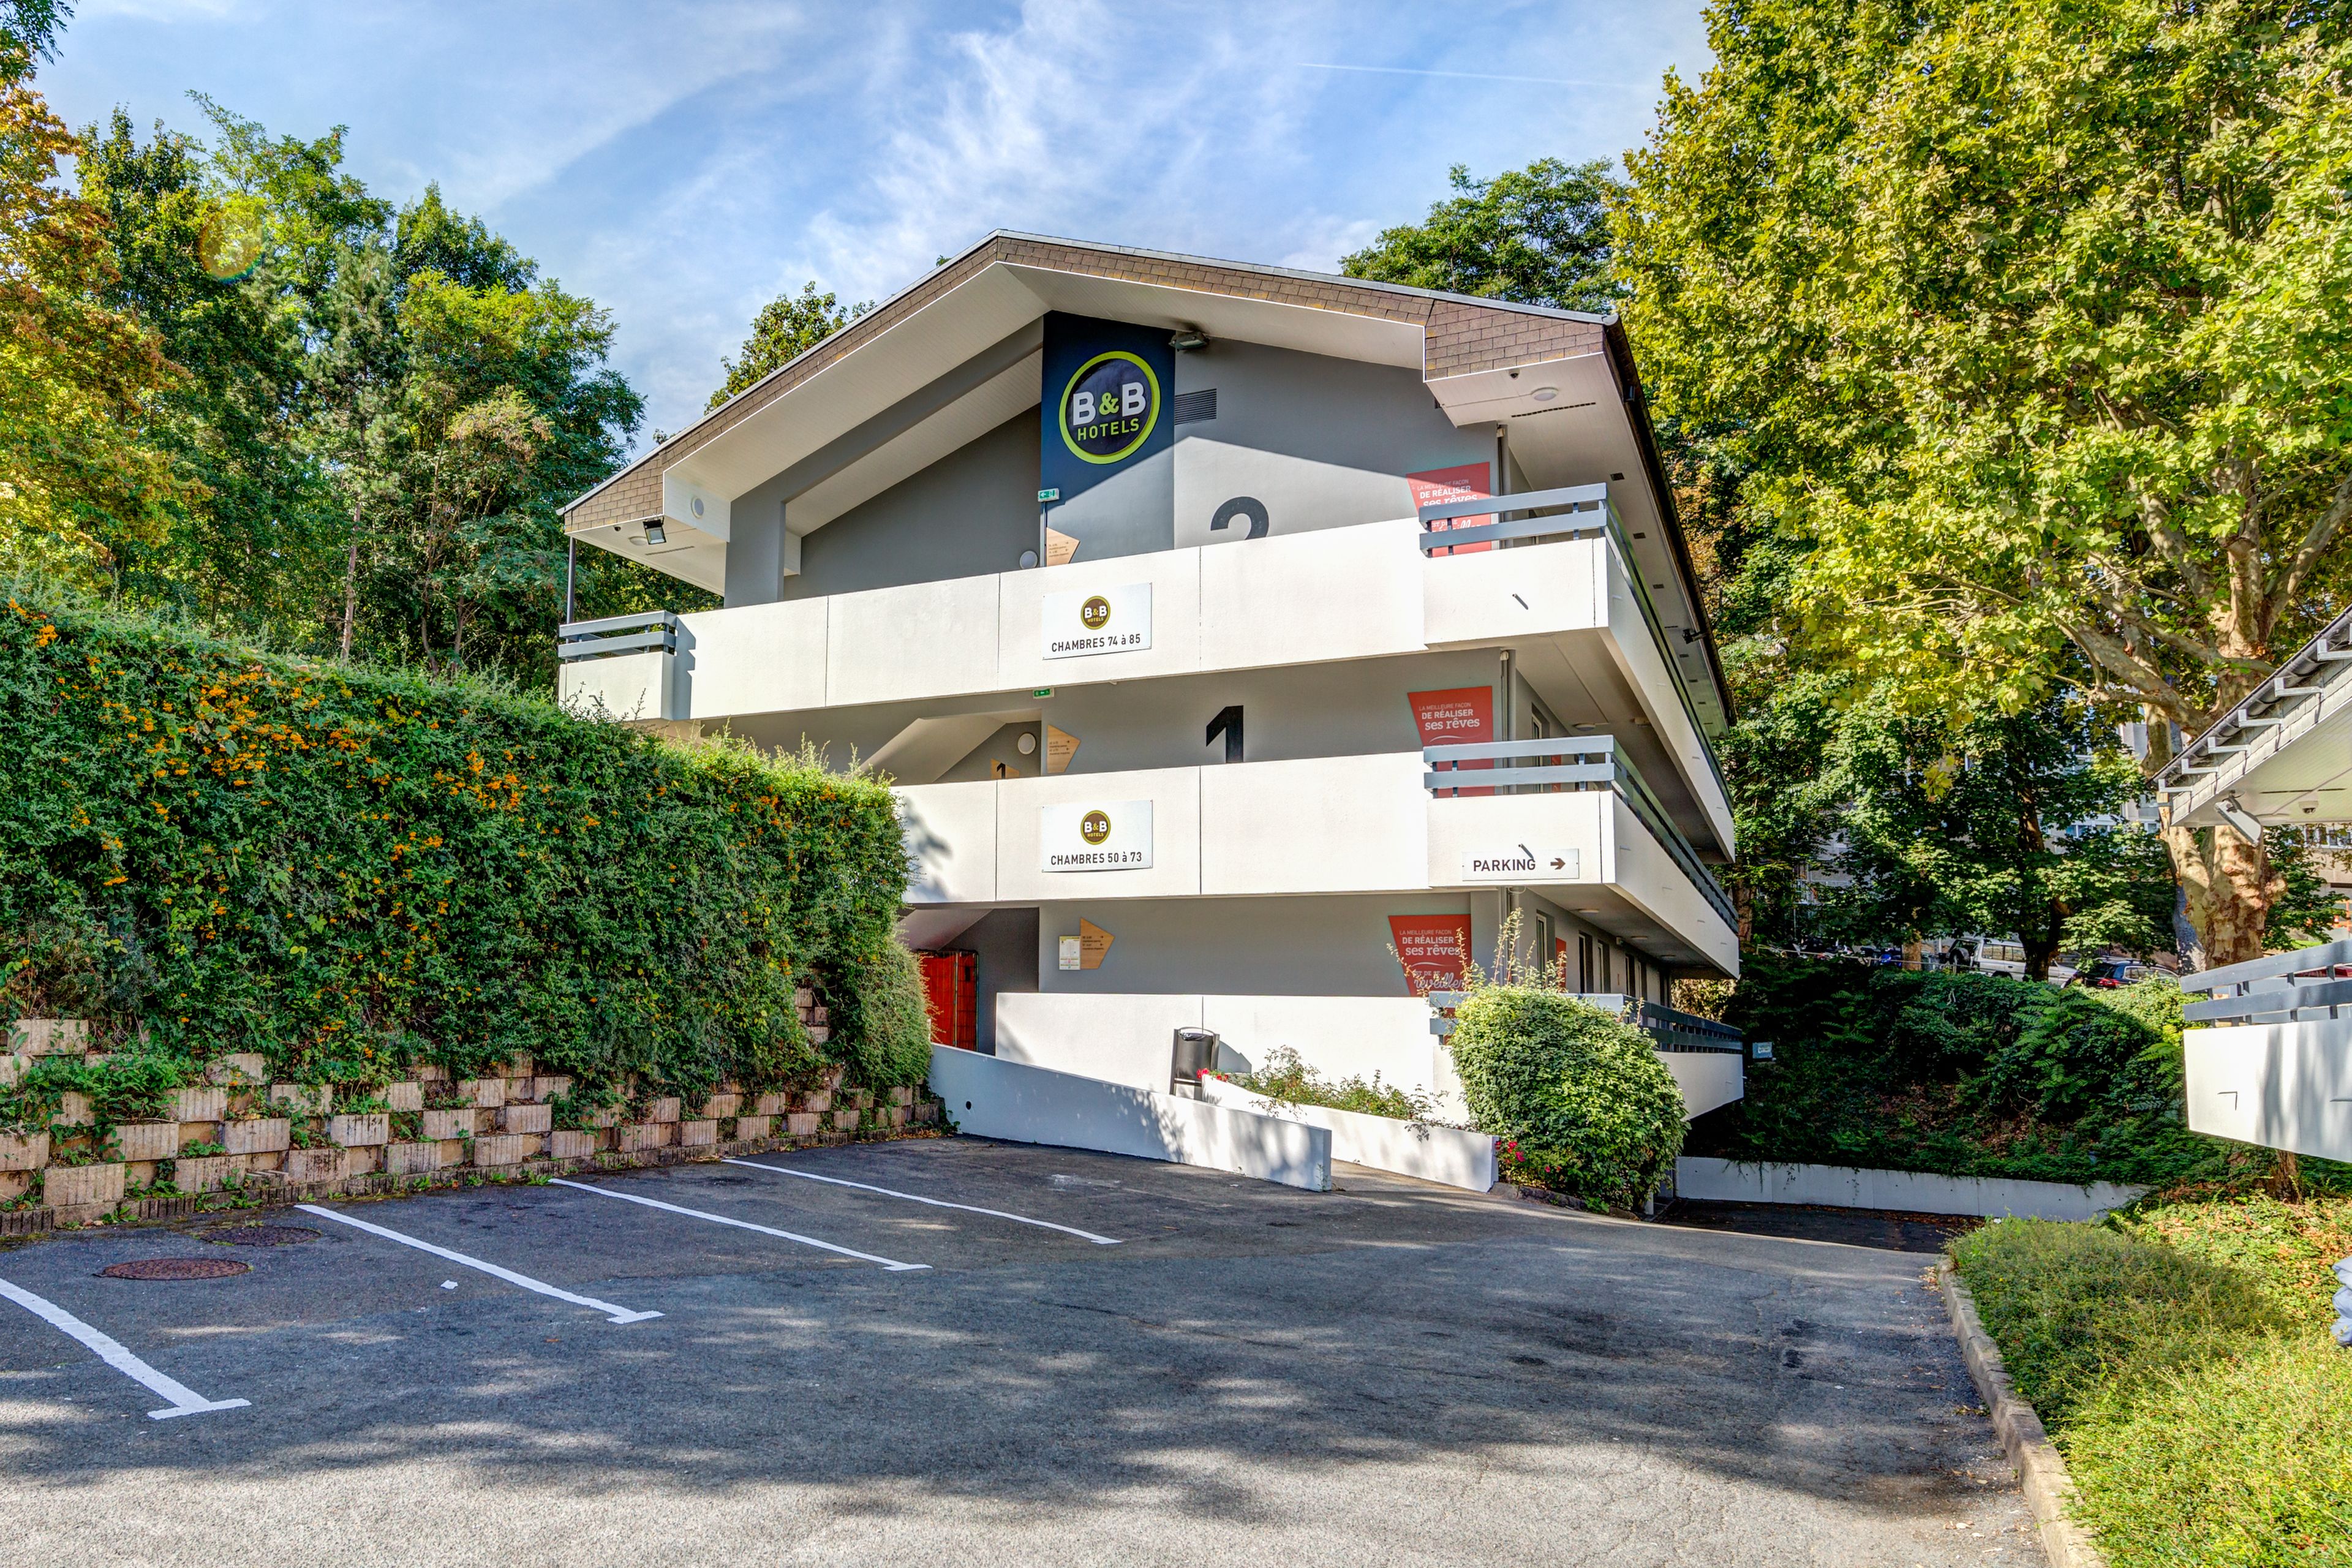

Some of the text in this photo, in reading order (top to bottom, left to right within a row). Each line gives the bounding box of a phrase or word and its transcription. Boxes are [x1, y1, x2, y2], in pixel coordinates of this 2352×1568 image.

[1072, 382, 1147, 426] B&B
[1077, 418, 1140, 441] HOTELS
[1432, 485, 1471, 497] RÉALISER
[1084, 605, 1107, 619] B&B
[1052, 633, 1140, 652] CHAMBRES 74 à 85
[1434, 709, 1474, 718] RÉALISER
[1425, 717, 1480, 731] ses rêves
[1206, 705, 1244, 763] 1
[1084, 821, 1107, 833] B&B
[1050, 851, 1142, 865] CHAMBRES 50 à 73
[1473, 859, 1536, 872] PARKING
[1415, 935, 1454, 944] RÉALISER
[1405, 944, 1461, 956] ses rêves
